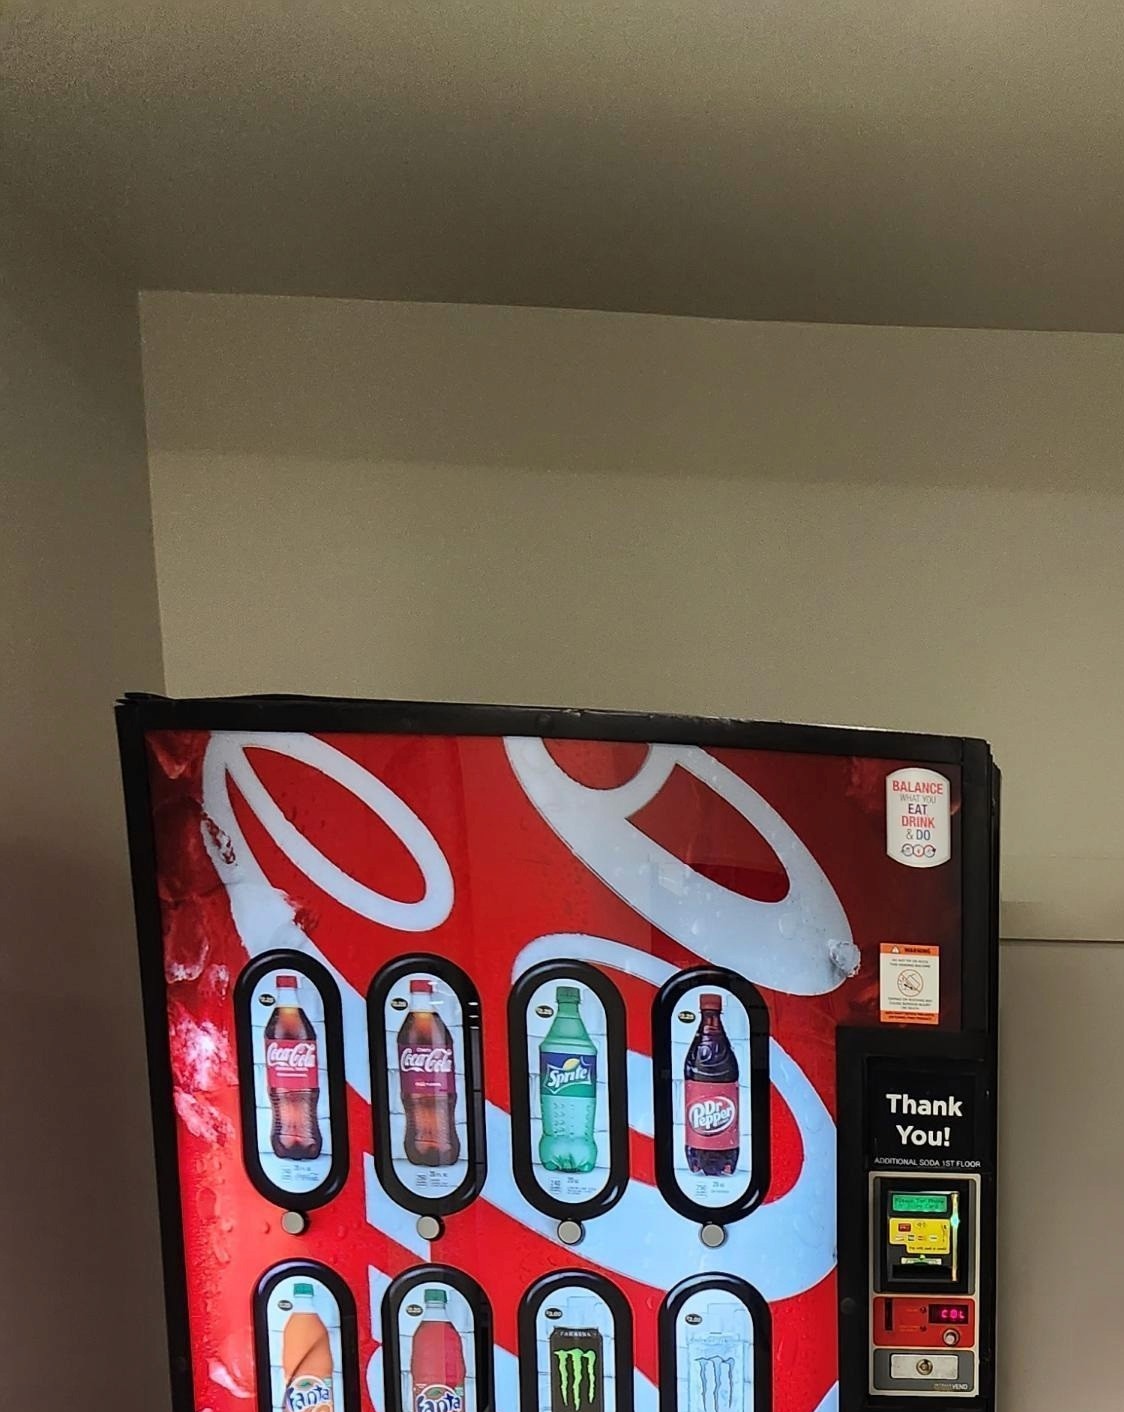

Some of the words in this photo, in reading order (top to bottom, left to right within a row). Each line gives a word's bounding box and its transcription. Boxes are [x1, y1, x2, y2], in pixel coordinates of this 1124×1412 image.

[893, 780, 943, 795] BALANCE
[901, 794, 920, 803] WHAT
[922, 795, 936, 804] YOU
[908, 804, 927, 815] EAT
[902, 816, 935, 828] DRINK
[906, 831, 914, 840] &
[916, 830, 931, 841] DO
[266, 1042, 316, 1068] Coca-Cola
[401, 1047, 453, 1073] Coca-Cola
[547, 1067, 590, 1087] Sprite
[705, 1101, 723, 1114] Dr
[886, 1093, 963, 1117] Thank
[692, 1106, 733, 1129] Pepper
[896, 1125, 951, 1147] You!
[874, 1157, 917, 1166] ADDITIONAL
[956, 1160, 981, 1168] FLOOR
[287, 1385, 330, 1412] Fanta
